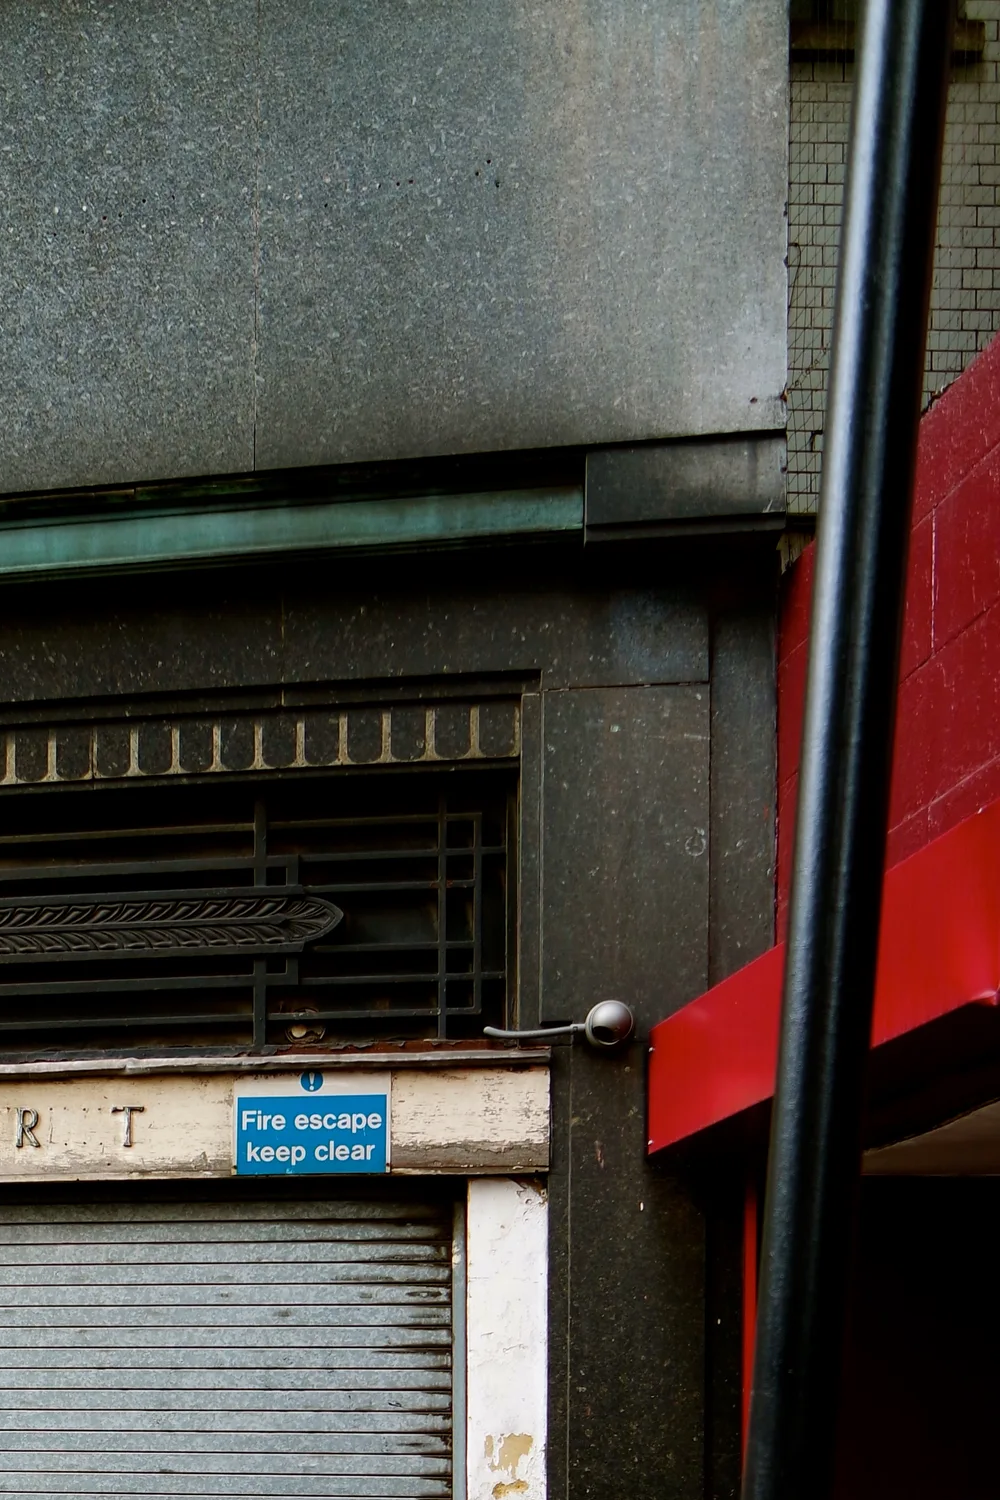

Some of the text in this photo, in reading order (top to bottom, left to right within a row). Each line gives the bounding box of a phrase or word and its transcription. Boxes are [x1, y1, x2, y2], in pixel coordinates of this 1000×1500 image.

[241, 1110, 382, 1134] Fire escape
[246, 1140, 376, 1166] keep clear
